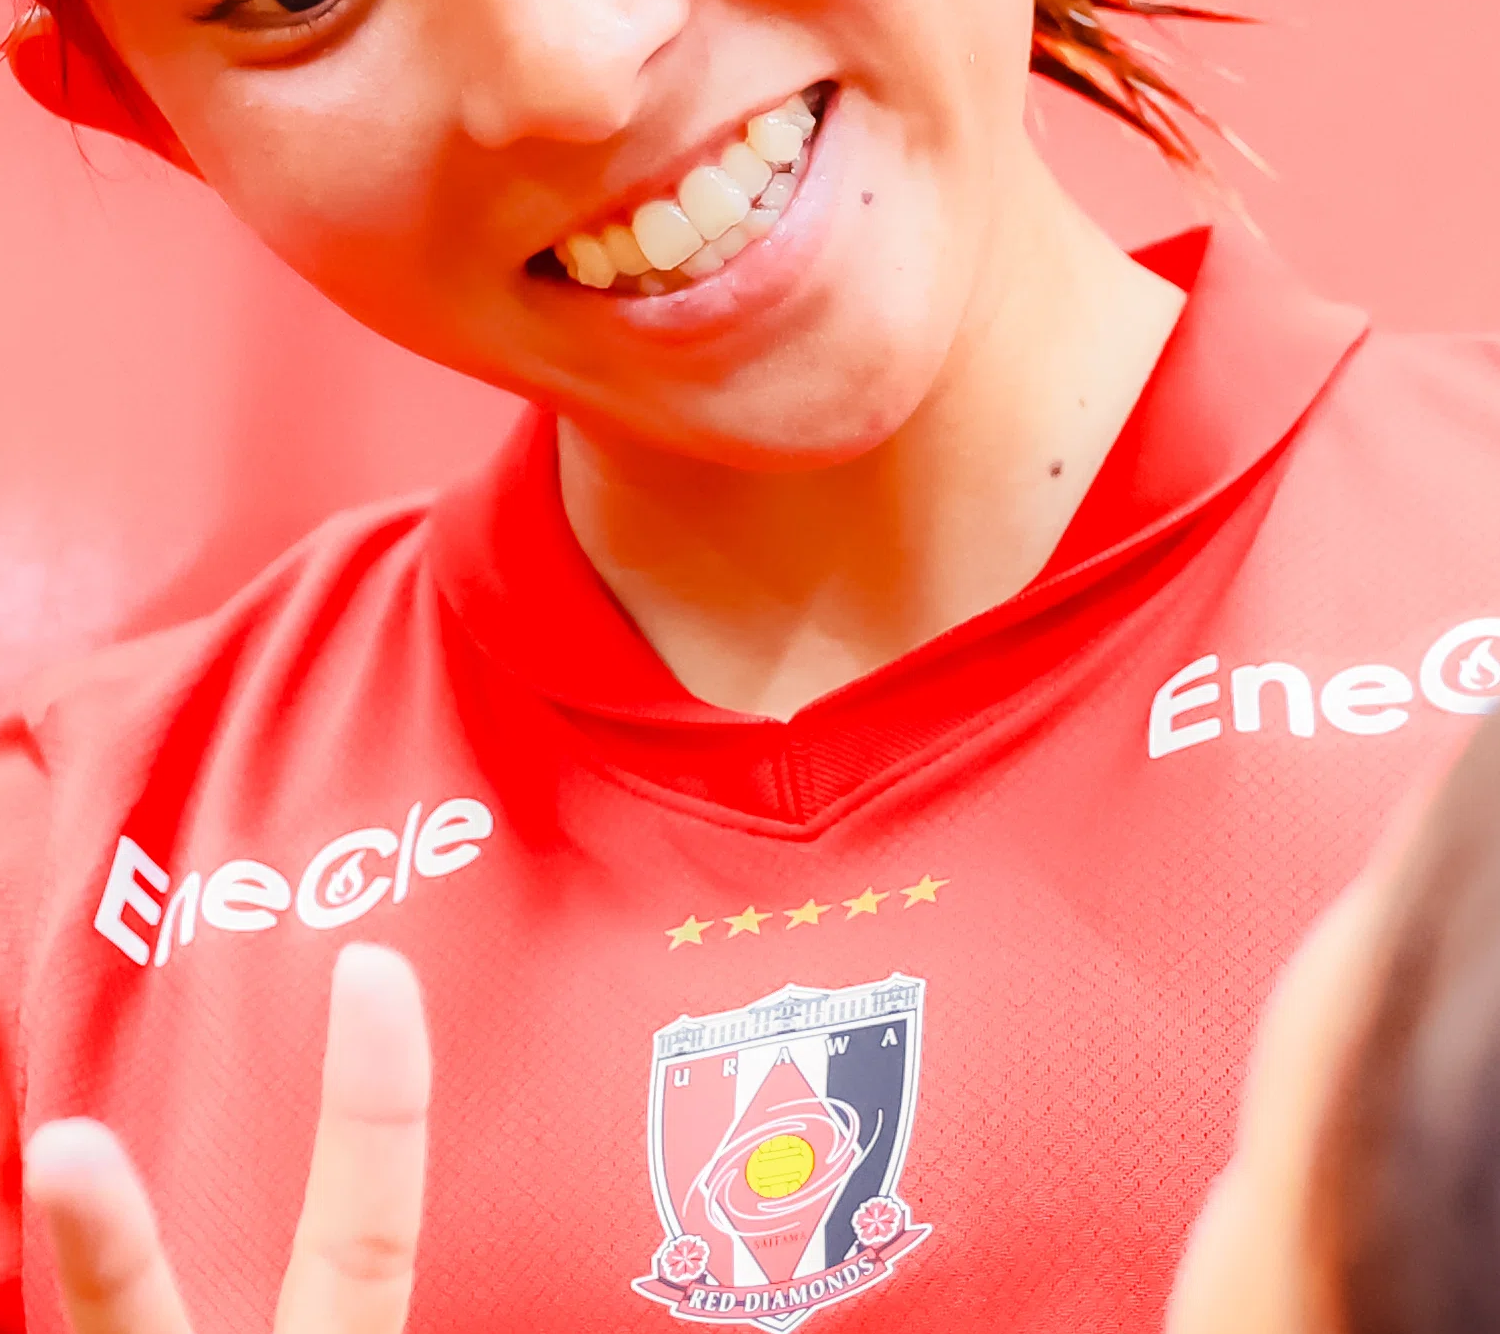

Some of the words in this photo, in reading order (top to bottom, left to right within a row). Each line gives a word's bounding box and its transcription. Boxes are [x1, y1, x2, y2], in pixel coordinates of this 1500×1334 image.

[94, 797, 494, 968] EneCle
[672, 1026, 899, 1088] URAWA
[690, 1289, 737, 1312] RED
[744, 1255, 876, 1314] DIAMONDS
